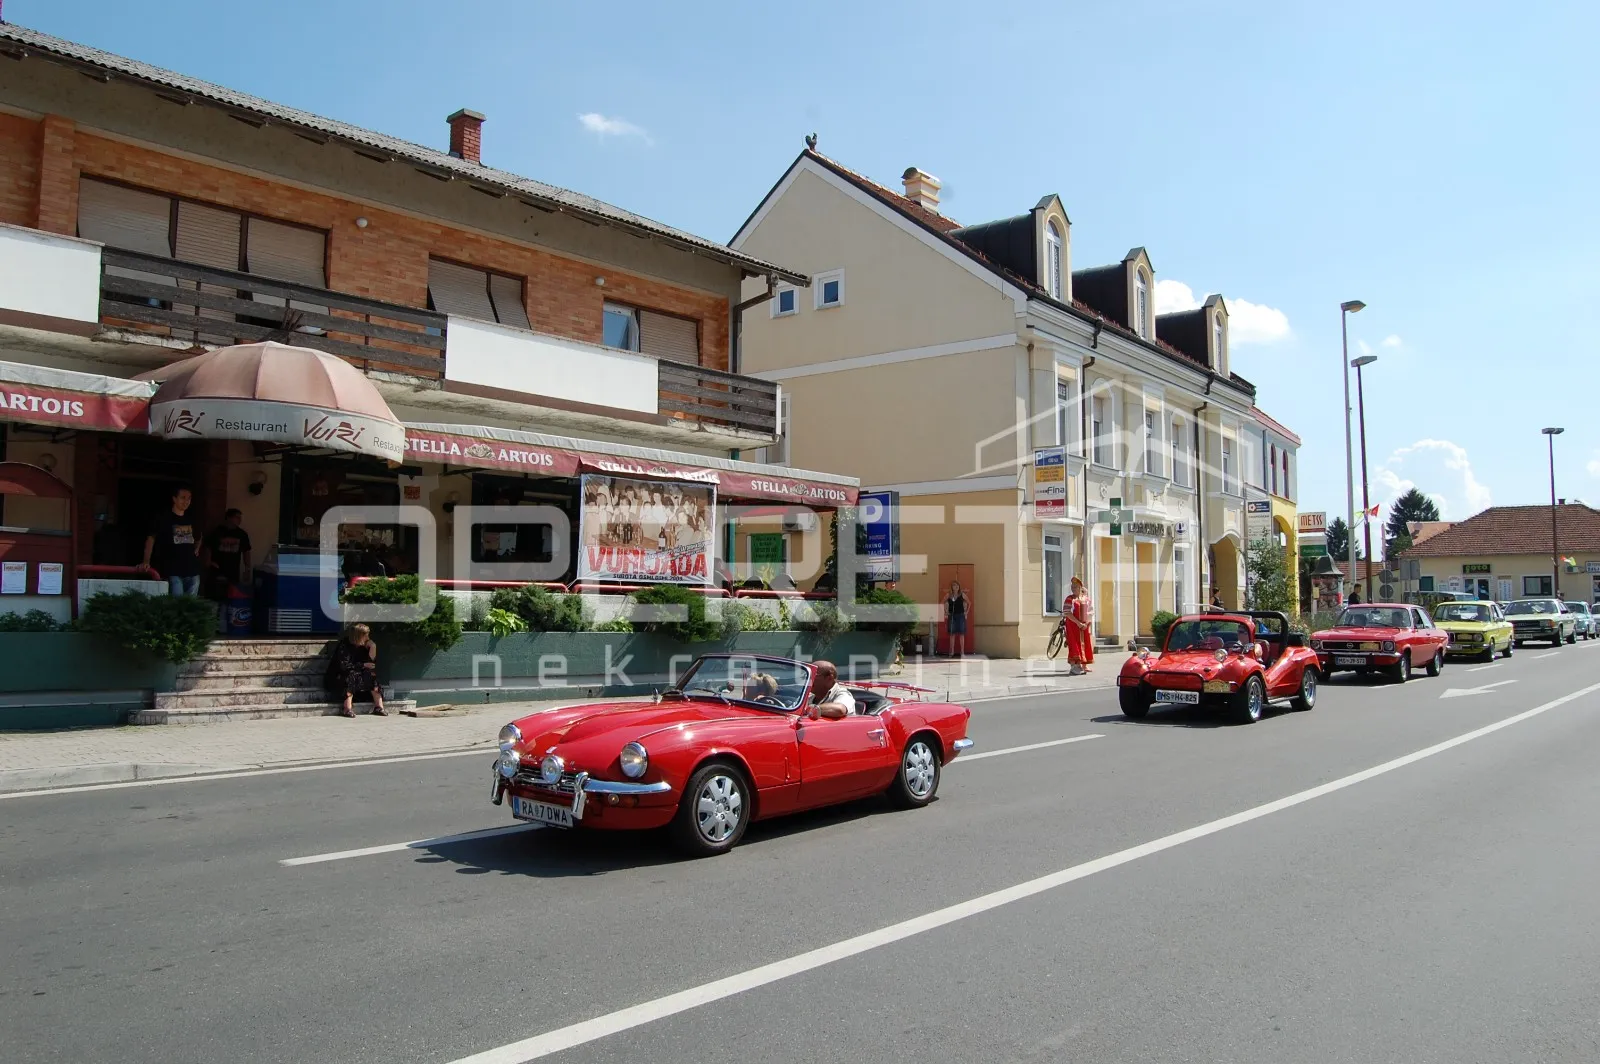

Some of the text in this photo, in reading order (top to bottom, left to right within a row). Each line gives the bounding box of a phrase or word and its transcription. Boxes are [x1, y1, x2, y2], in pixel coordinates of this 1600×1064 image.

[215, 418, 288, 433] Restaurant
[403, 437, 554, 467] STELLA ARTOIS
[751, 479, 847, 501] STELLA ARTOIS
